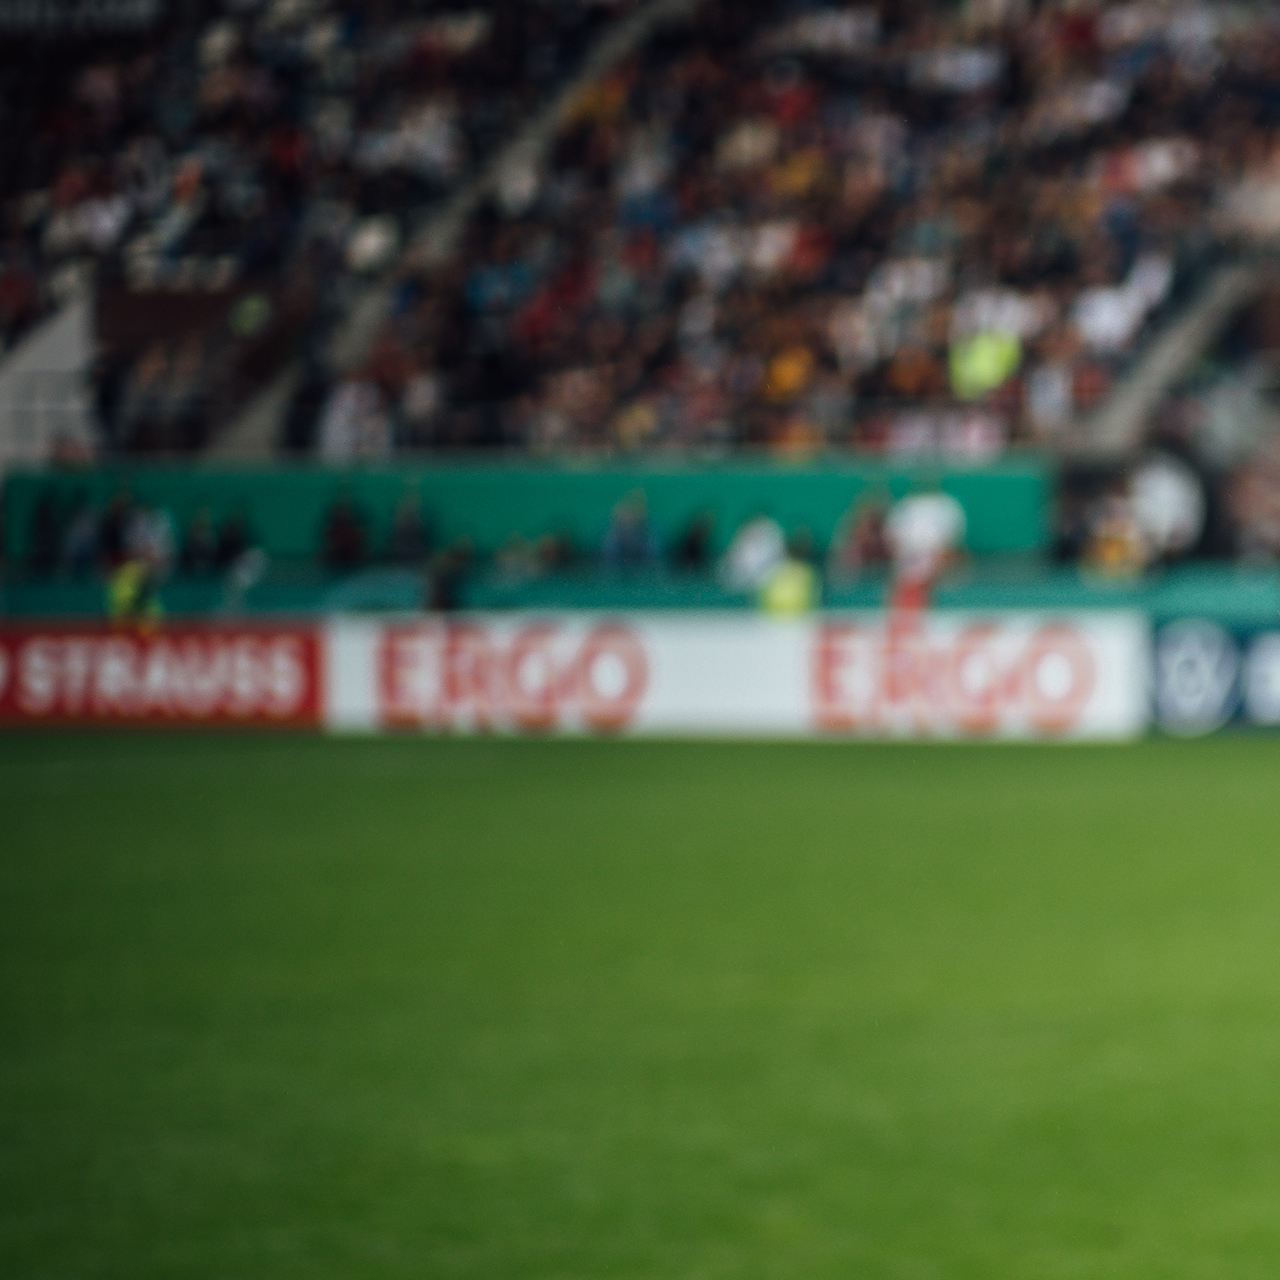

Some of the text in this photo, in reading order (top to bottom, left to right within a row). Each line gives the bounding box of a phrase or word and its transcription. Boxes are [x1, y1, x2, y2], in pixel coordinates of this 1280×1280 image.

[19, 633, 306, 718] STRAUSS
[378, 622, 651, 734] ERGO
[811, 621, 1099, 735] ERGO
